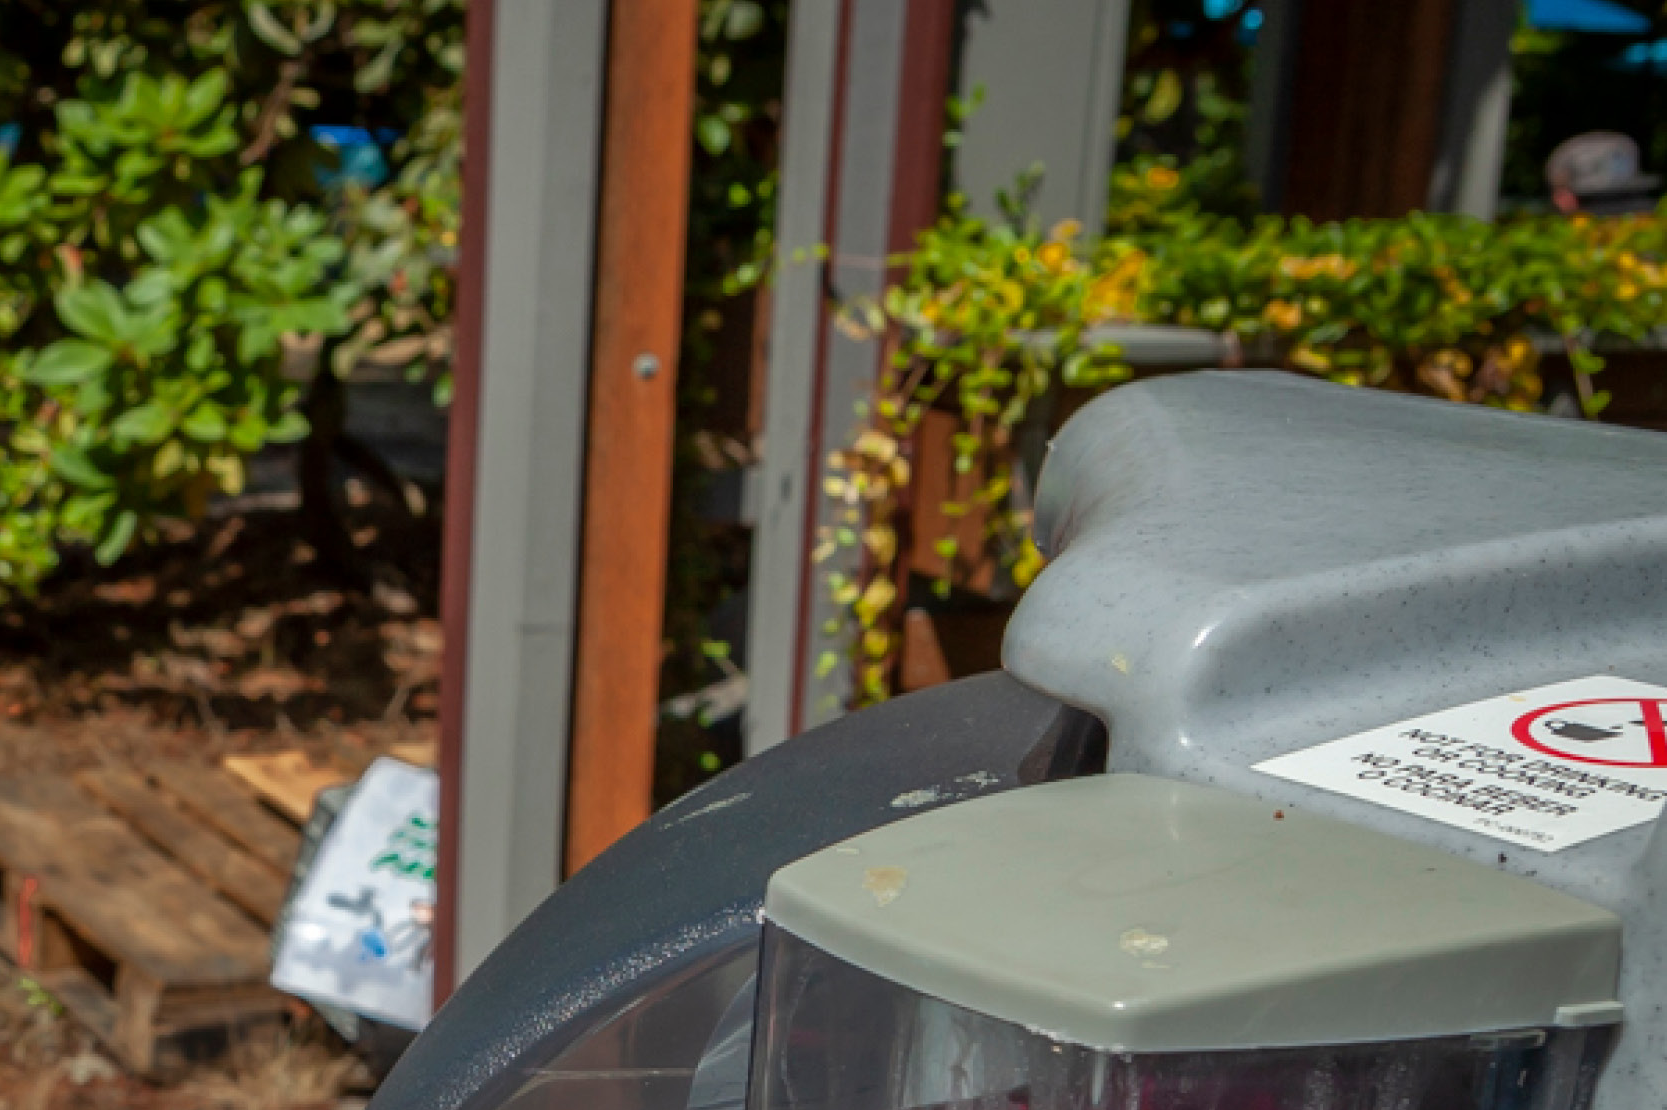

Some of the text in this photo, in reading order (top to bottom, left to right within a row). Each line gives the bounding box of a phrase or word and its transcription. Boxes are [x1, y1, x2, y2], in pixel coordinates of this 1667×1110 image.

[1350, 751, 1579, 817] NO PARA BEBER
[1356, 770, 1516, 816] O COCINAR
[1398, 728, 1667, 801] NOT FOR DRINKING
[1412, 745, 1596, 797] OR COOKING
